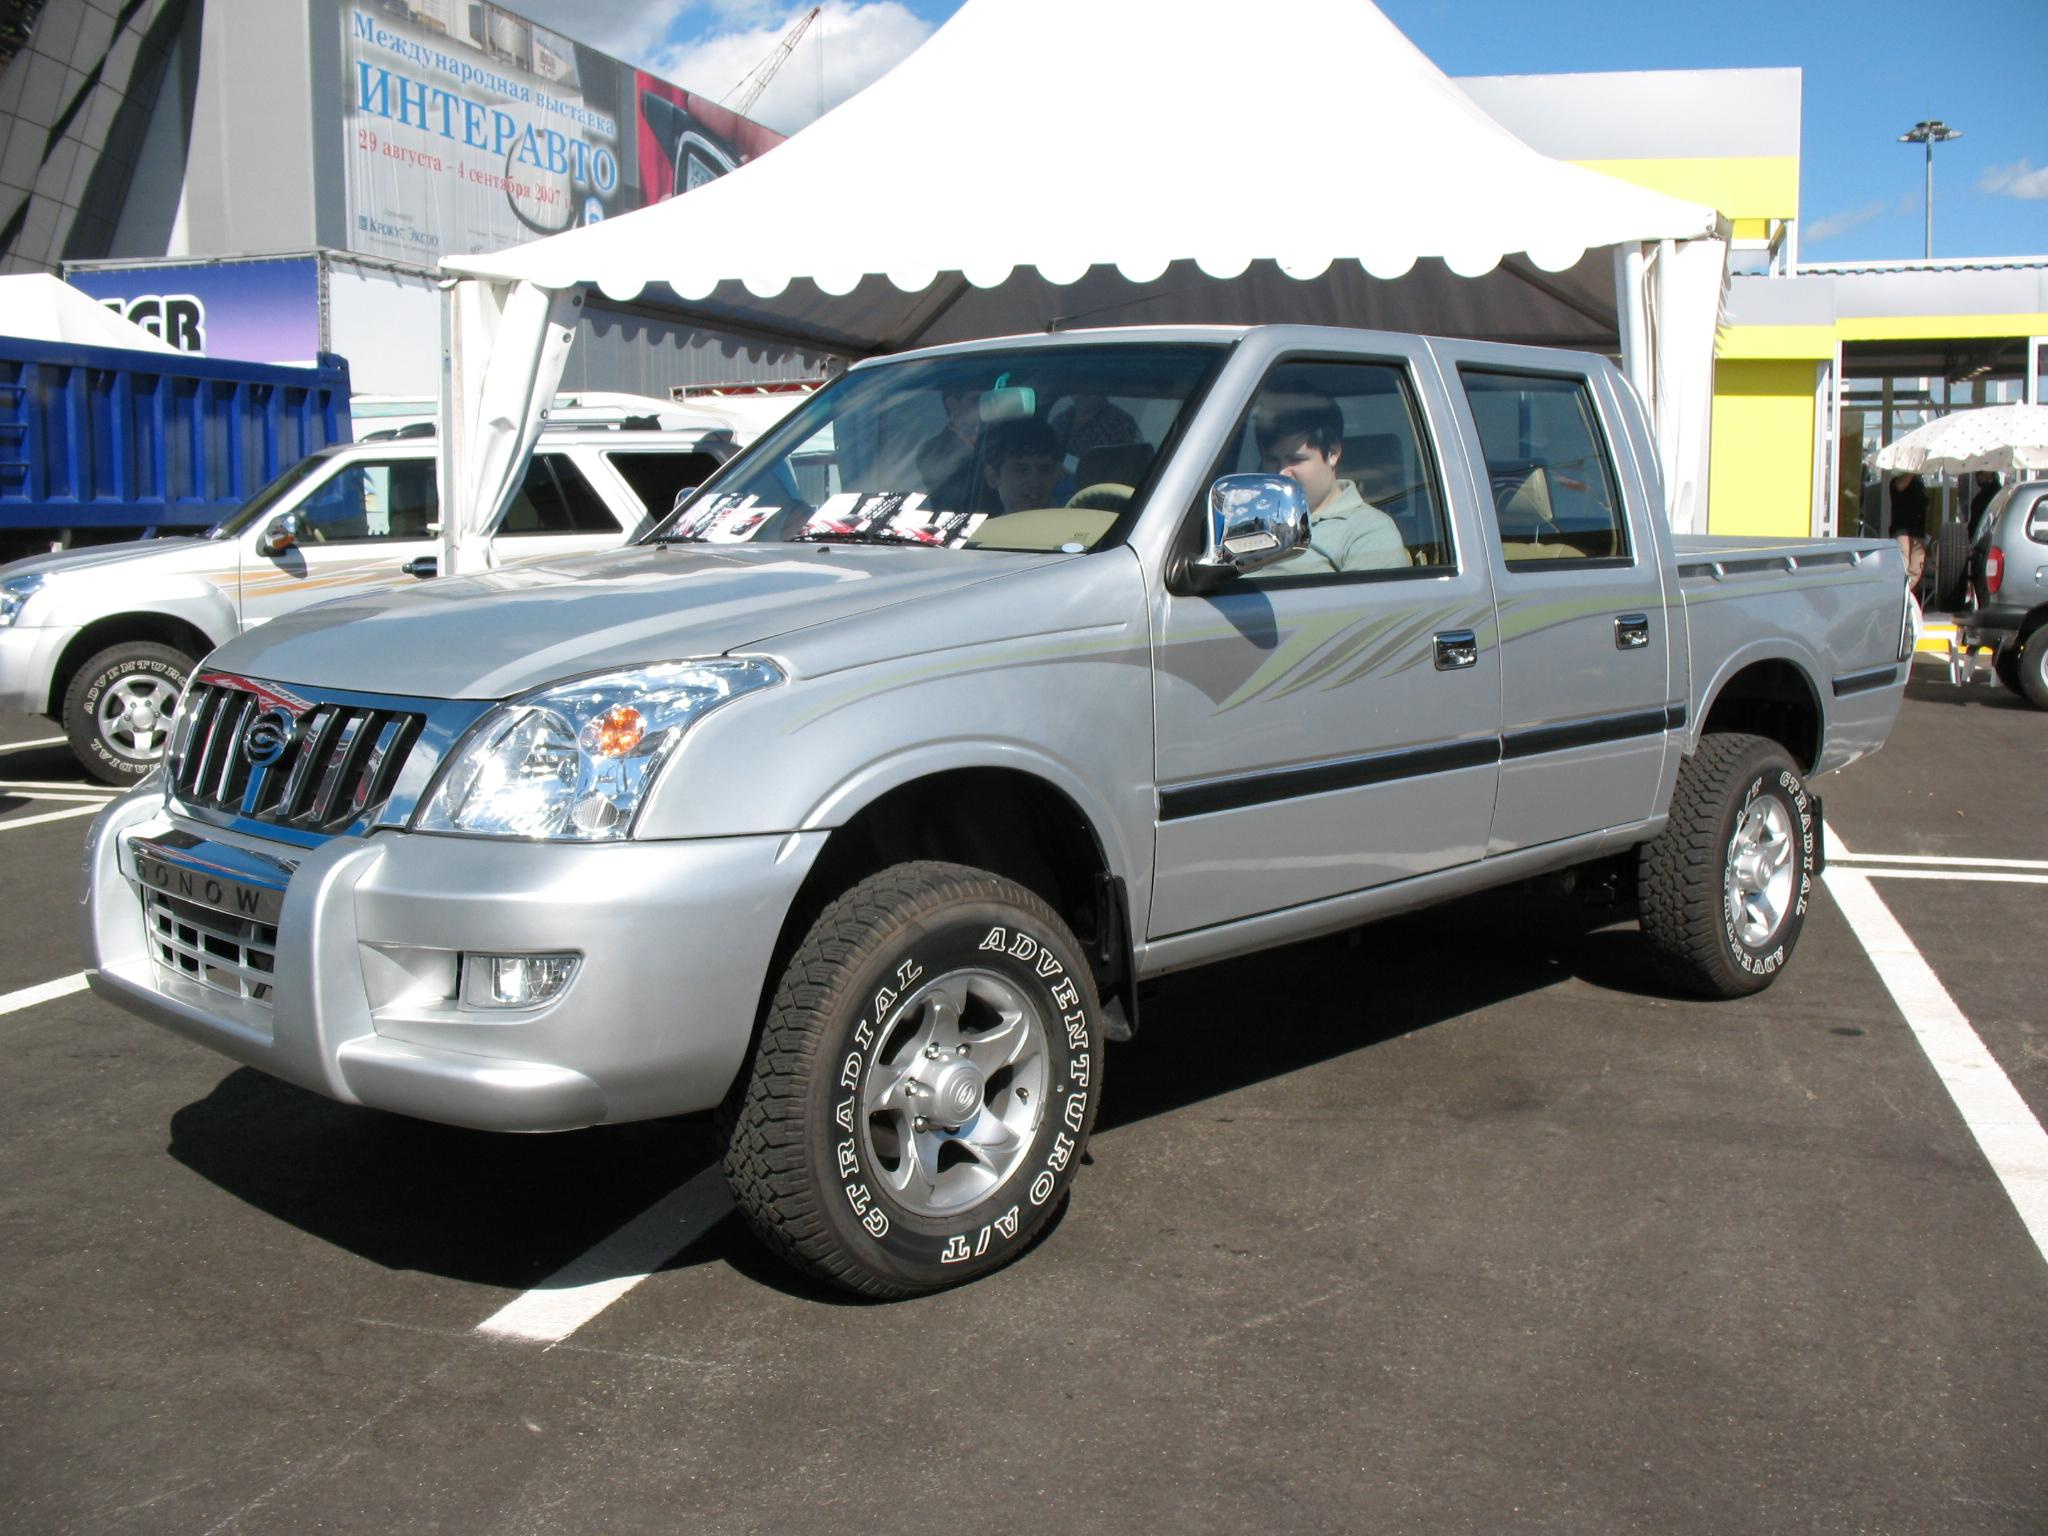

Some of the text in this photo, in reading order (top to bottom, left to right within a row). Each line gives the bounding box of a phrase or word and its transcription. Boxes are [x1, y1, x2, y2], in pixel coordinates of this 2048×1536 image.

[353, 10, 615, 135] Международная выставка
[356, 60, 618, 192] ИНТЕРАВТО
[358, 128, 378, 152] 29
[383, 142, 443, 171] августа
[457, 160, 465, 179] 4
[469, 168, 531, 200] сентября
[534, 183, 561, 207] 2007
[98, 294, 206, 358] GR
[136, 858, 260, 915] GONOW
[980, 927, 1090, 1205] ADVENTURO
[940, 1206, 1021, 1264] A/T
